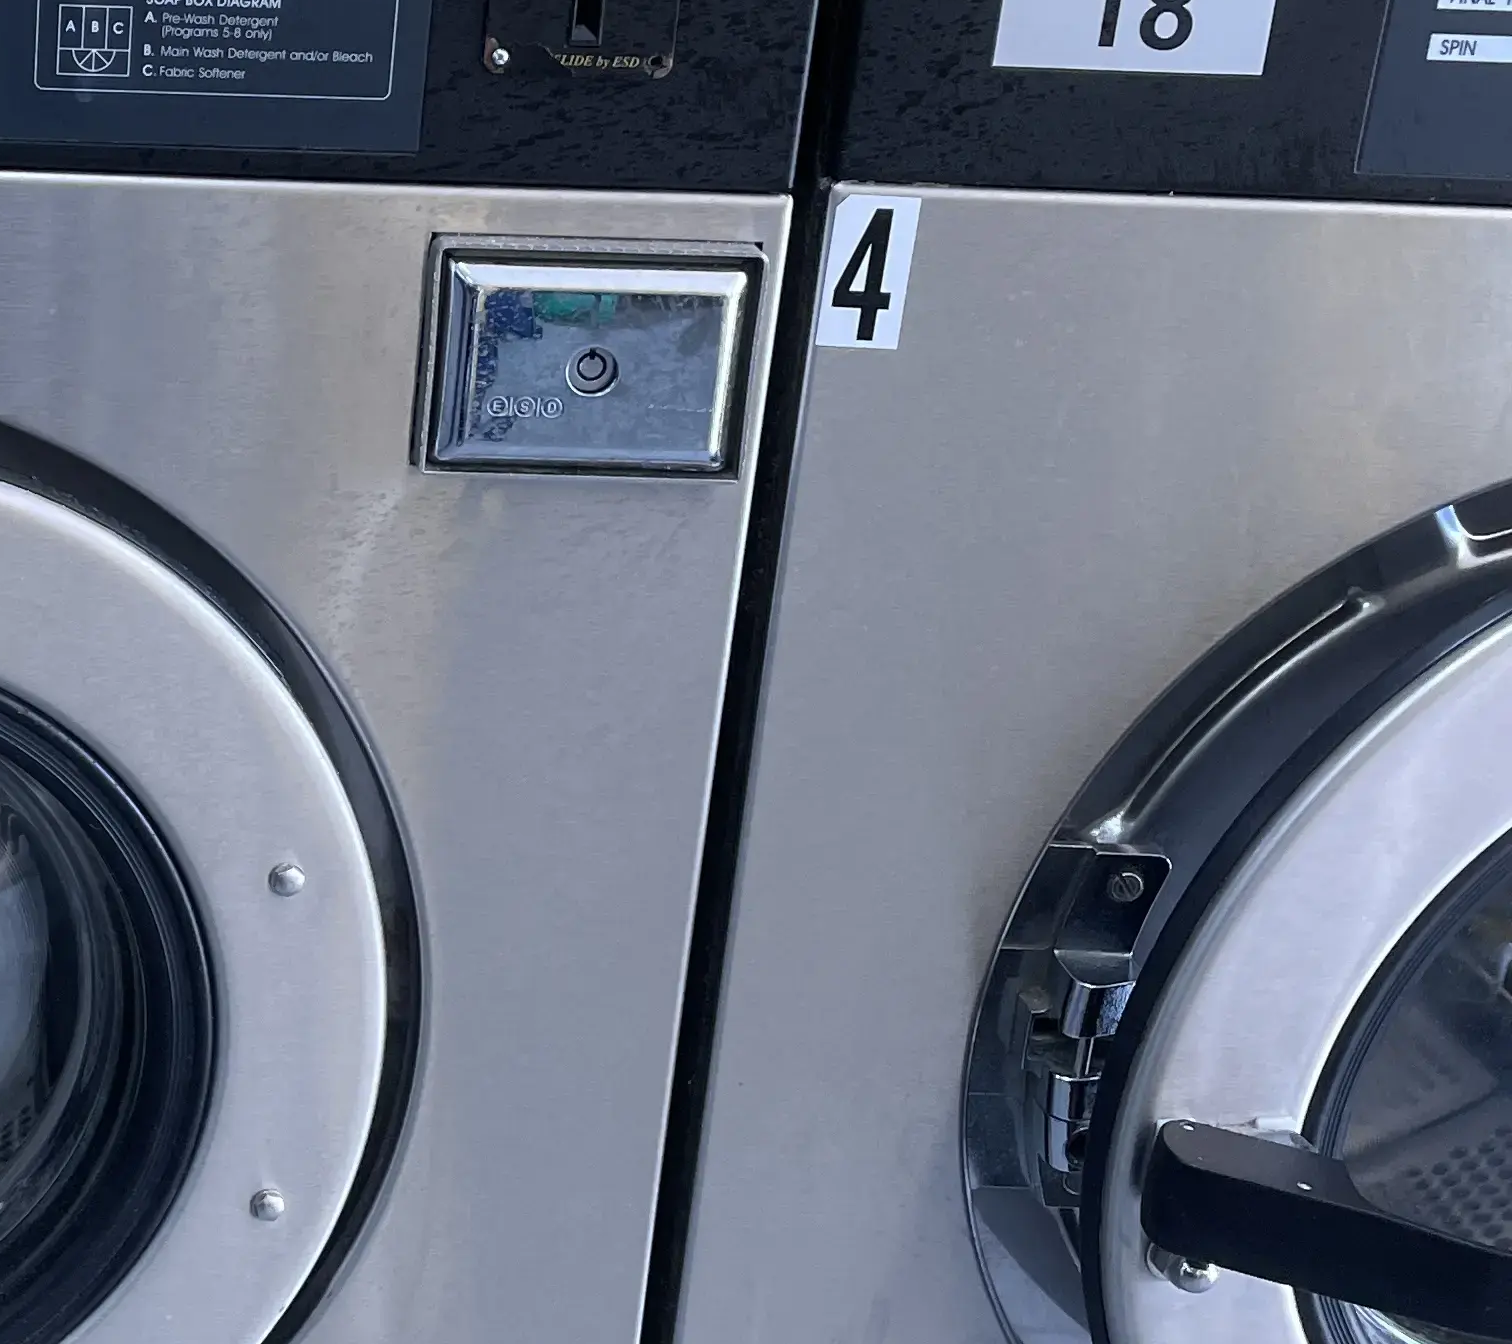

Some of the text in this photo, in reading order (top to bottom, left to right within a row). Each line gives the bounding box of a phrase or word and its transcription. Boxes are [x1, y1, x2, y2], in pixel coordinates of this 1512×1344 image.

[65, 20, 124, 35] A B C
[143, 11, 280, 29] A. Pre-Wash Detergent
[161, 23, 274, 42] (Programs 5-8 only)
[143, 44, 374, 64] B. Main Wash Detergent and/or Bleach
[1438, 38, 1478, 57] SPIN
[141, 64, 247, 80] C. Fabric Softener
[595, 55, 611, 71] by
[612, 56, 641, 69] ESD
[831, 208, 895, 342] 4
